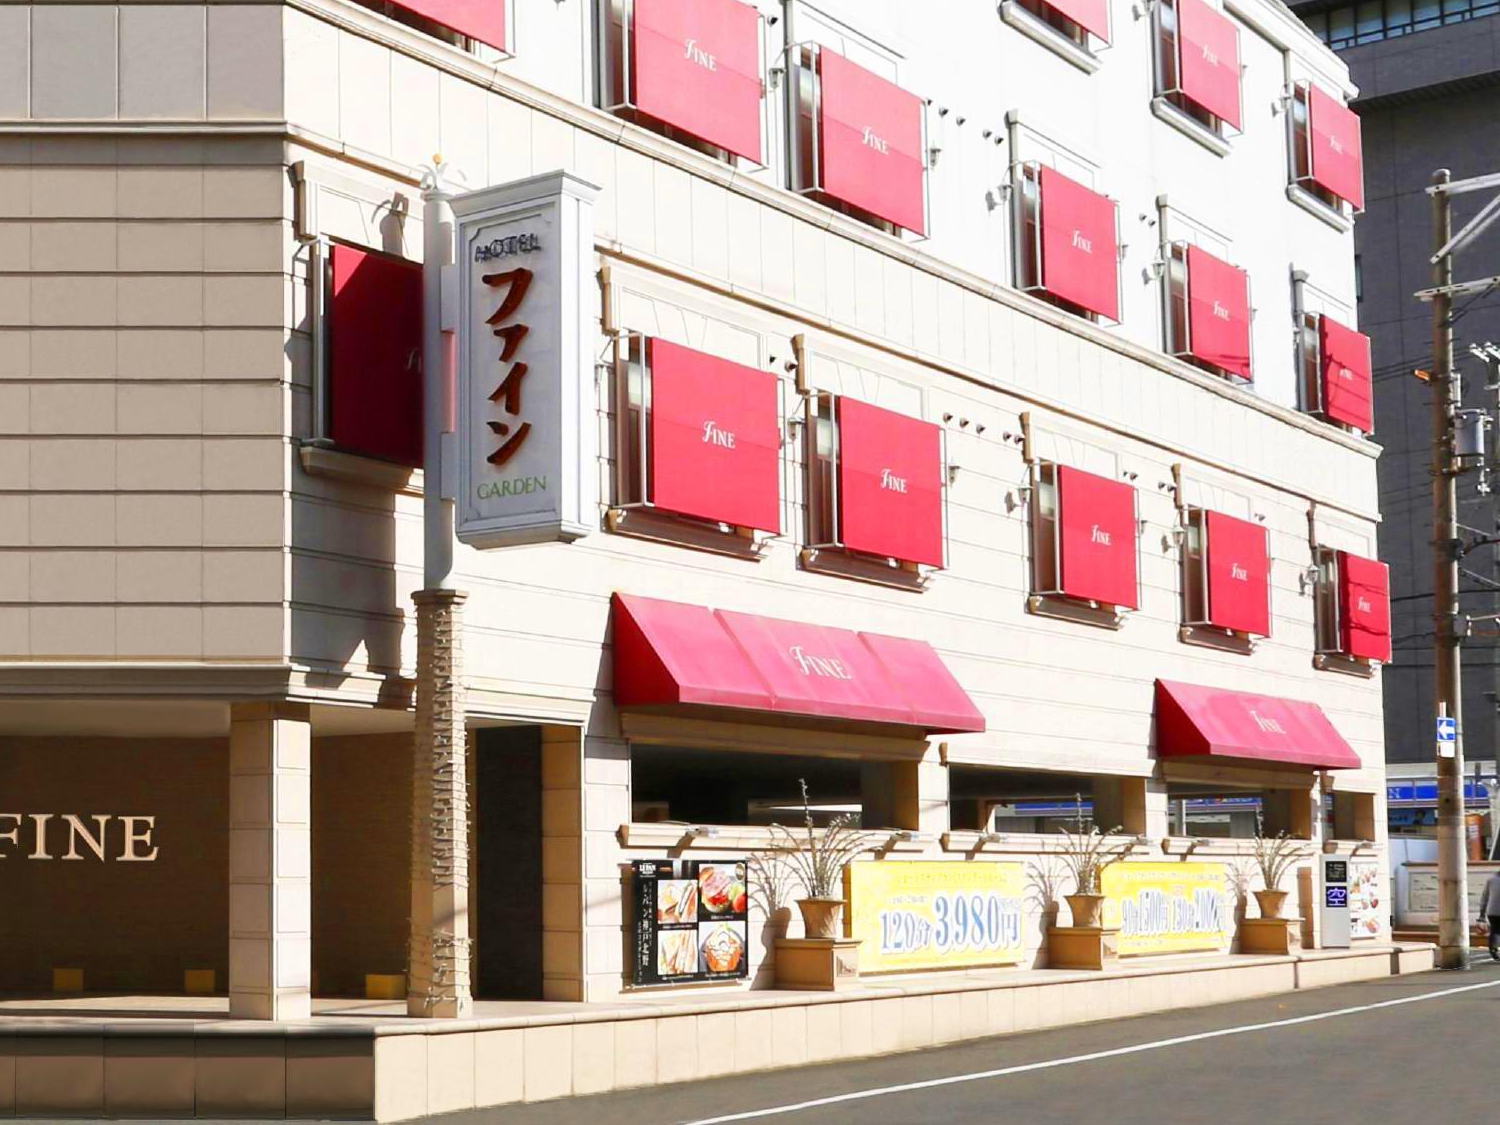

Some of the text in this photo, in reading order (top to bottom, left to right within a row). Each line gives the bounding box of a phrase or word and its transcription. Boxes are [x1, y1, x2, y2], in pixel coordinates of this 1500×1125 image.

[684, 39, 716, 71] FINE
[862, 127, 888, 155] FINE
[475, 233, 541, 262] HOTEL
[1073, 231, 1092, 253] FINE
[1214, 301, 1229, 320] FINE
[482, 267, 534, 467] ファイン
[702, 421, 735, 448] FINE
[476, 475, 547, 500] GARDEN
[882, 469, 907, 493] FINE
[1092, 525, 1110, 545] FINE
[1232, 563, 1247, 581] FINE
[789, 646, 852, 679] FINE
[1327, 887, 1346, 906] 空
